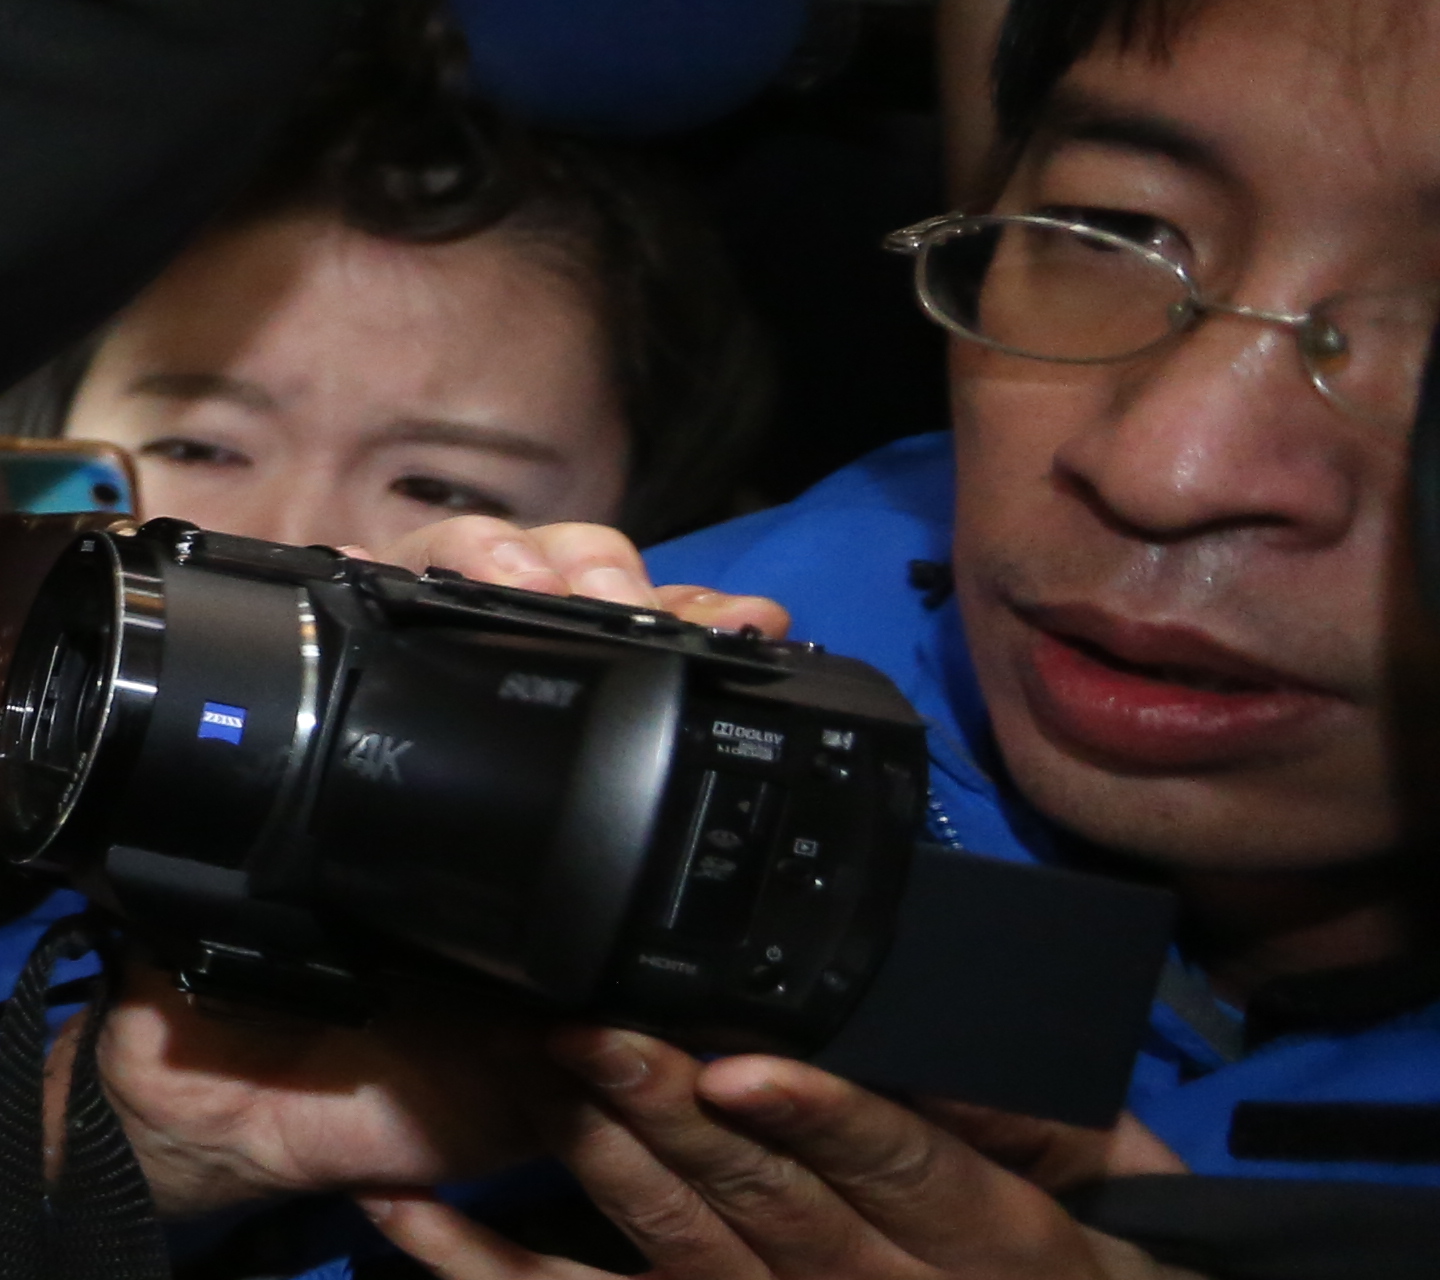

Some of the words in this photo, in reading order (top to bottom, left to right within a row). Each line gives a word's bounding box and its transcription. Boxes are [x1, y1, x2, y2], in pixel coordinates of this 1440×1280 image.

[202, 709, 244, 729] ZEISS
[734, 725, 786, 745] DOLBY
[344, 732, 415, 784] 4K
